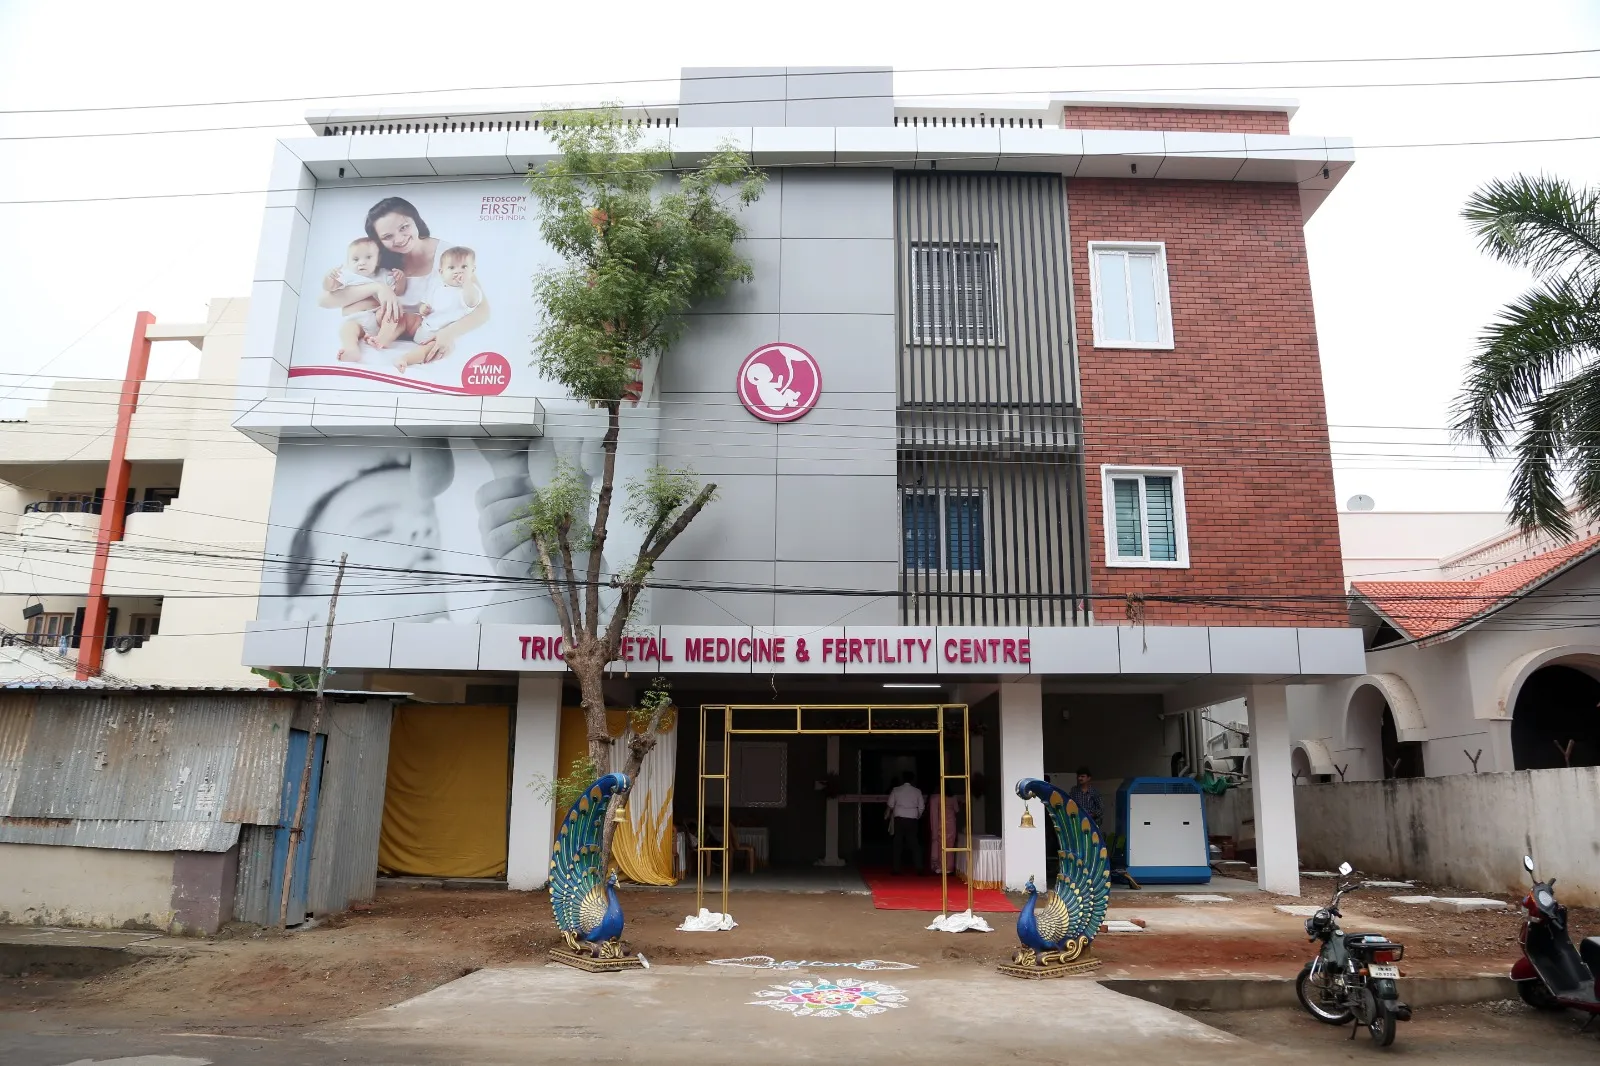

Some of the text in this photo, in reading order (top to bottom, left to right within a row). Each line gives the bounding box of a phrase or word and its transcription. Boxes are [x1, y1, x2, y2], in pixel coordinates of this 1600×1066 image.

[480, 203, 517, 215] FIRST
[473, 365, 502, 374] TWIN
[467, 375, 505, 385] CLINIC
[620, 637, 673, 662] ETAL
[685, 637, 785, 663] MEDICINE
[796, 638, 810, 662] &
[822, 638, 931, 663] FERTILITY
[944, 638, 1031, 663] CENTRE
